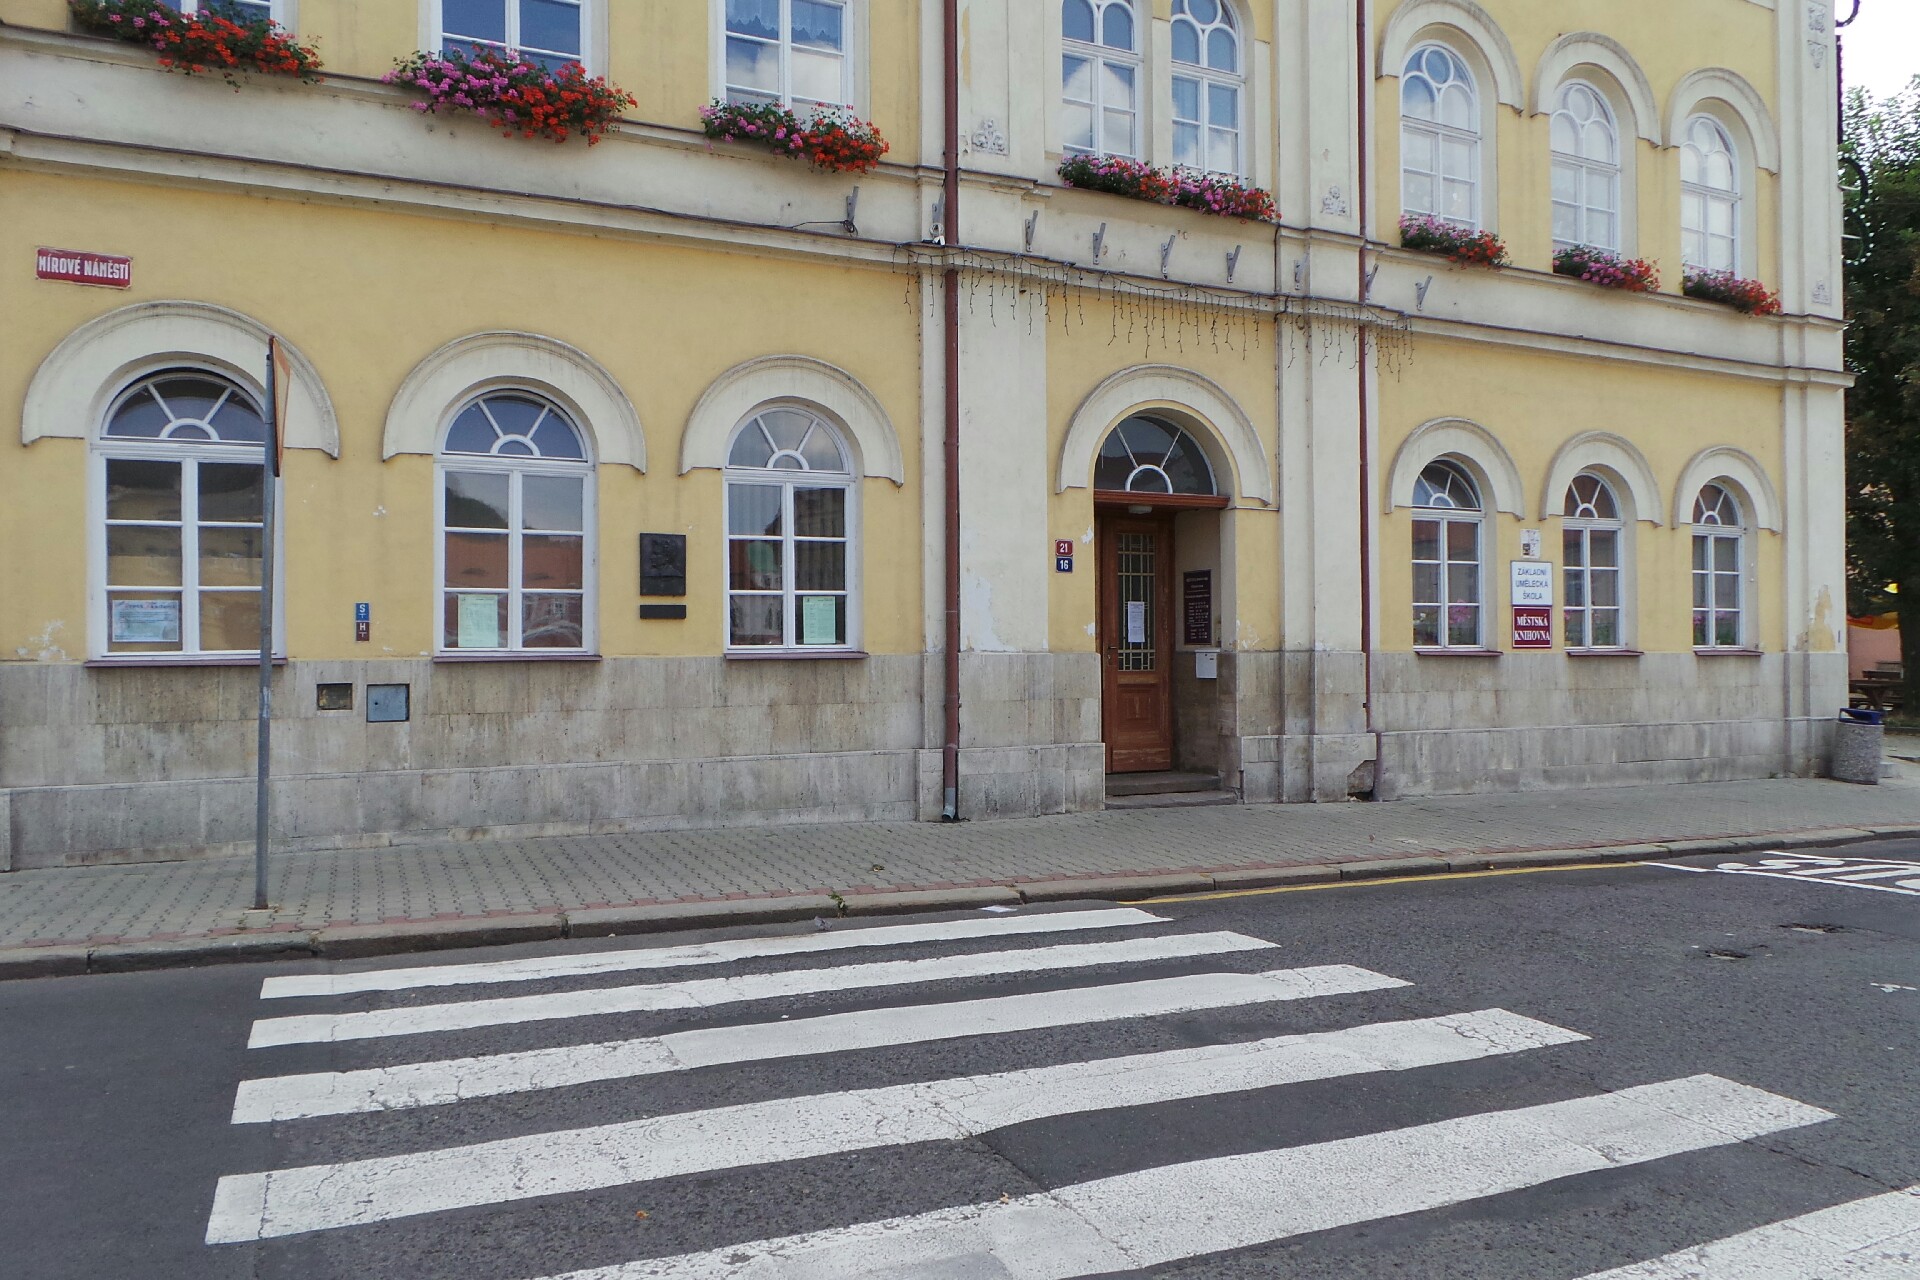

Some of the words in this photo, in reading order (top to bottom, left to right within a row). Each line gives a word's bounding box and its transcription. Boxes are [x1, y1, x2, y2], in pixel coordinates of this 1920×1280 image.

[38, 253, 81, 275] MÍROVÉ
[84, 258, 130, 280] NÁMĚSTÍ
[1060, 543, 1068, 553] 21
[1060, 560, 1069, 570] 16
[1522, 591, 1543, 600] ŠKOLA
[359, 604, 366, 613] S
[1516, 614, 1548, 626] MĚSTSKÁ
[359, 622, 366, 631] H
[1514, 630, 1551, 641] KNIHOVNA
[1717, 858, 1920, 890] US
